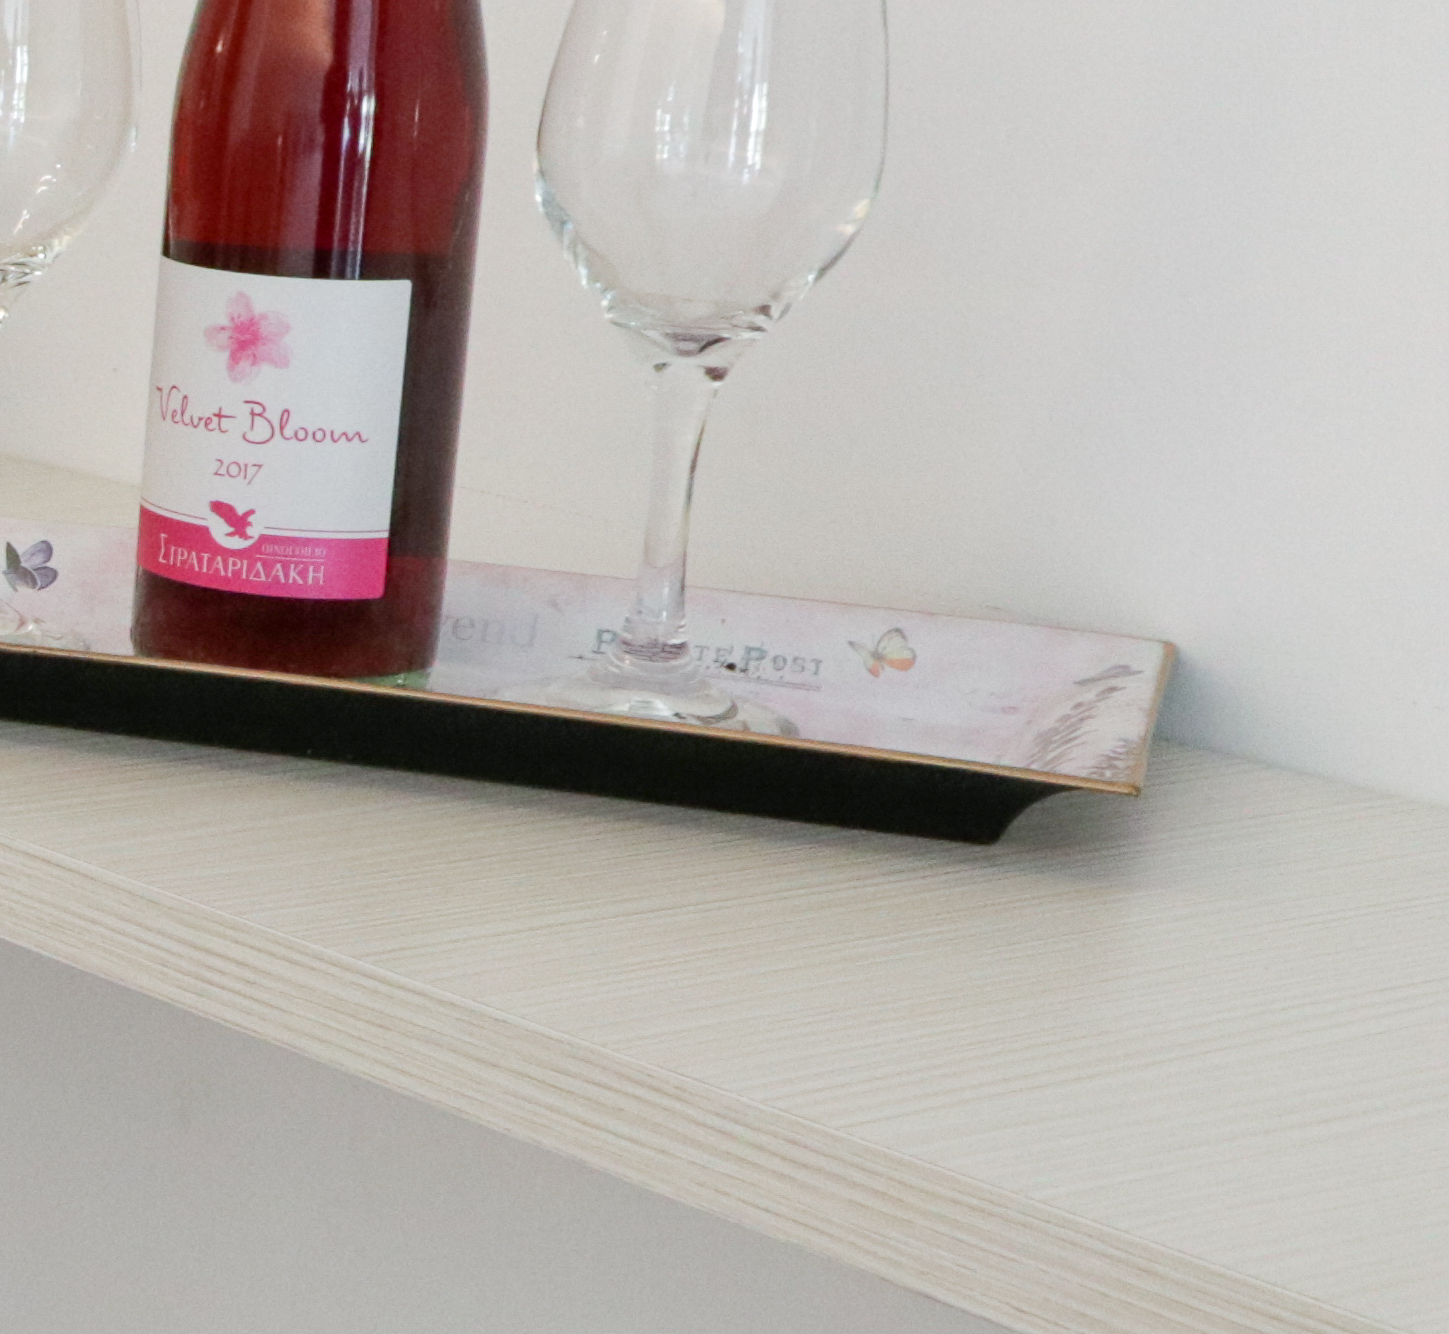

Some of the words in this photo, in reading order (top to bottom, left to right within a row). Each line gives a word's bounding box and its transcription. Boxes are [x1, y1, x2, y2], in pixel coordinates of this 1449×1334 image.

[156, 385, 237, 434] Velvet
[242, 400, 369, 445] Bloom
[214, 459, 264, 485] 2017
[158, 533, 325, 585] ΣΤΡΑΤΑΡΙΔΑΚΗ
